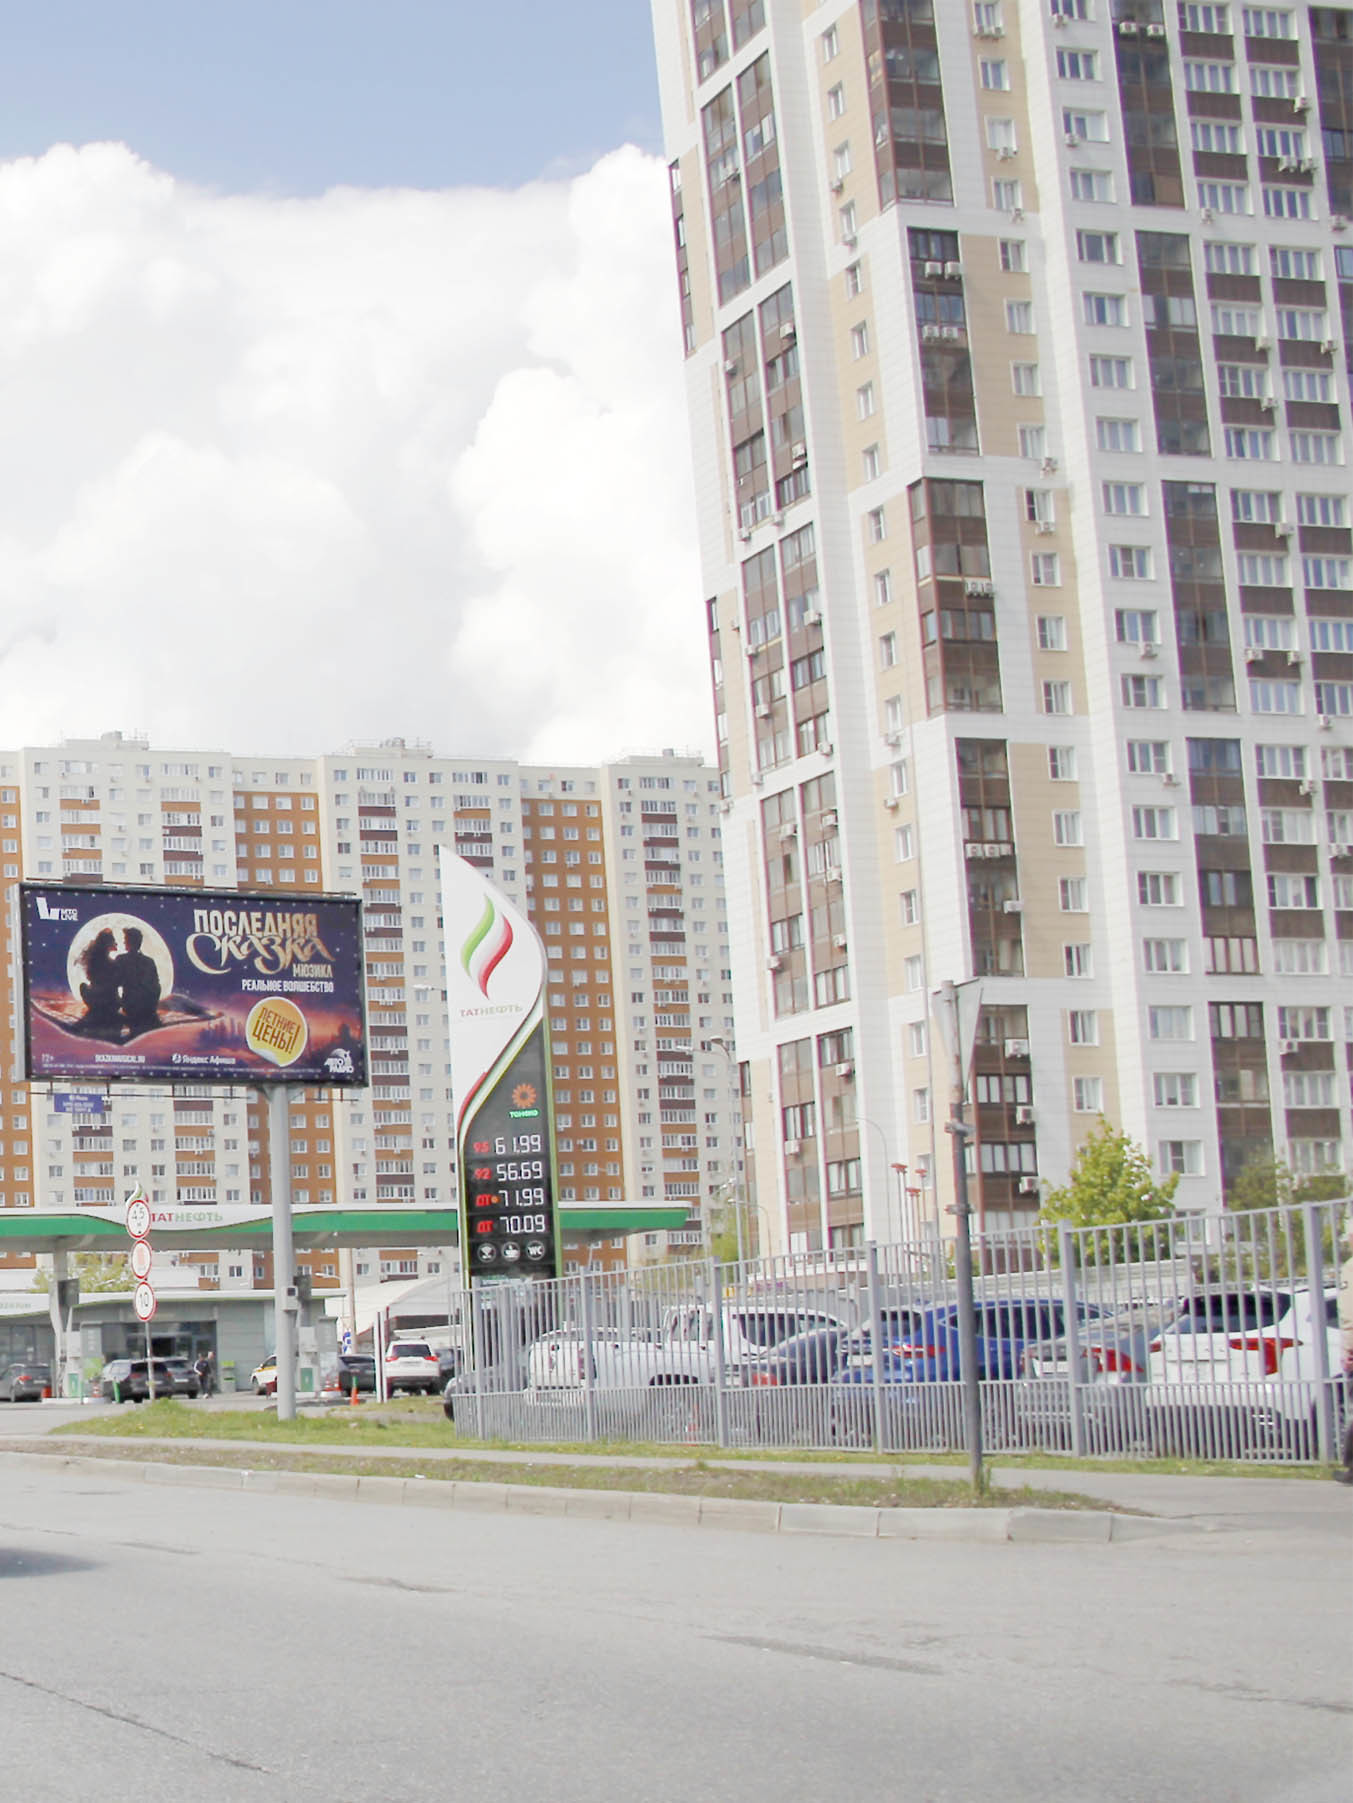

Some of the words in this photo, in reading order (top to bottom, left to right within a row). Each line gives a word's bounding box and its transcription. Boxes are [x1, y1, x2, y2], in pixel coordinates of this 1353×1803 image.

[193, 909, 318, 938] ПОСЛЕДНЯЯ
[293, 963, 333, 978] МЮЗИКЛ
[242, 979, 283, 991] РЕАЛЬНОЕ
[283, 980, 334, 993] ВОЛШЕБСТВО
[460, 1004, 523, 1017] ТАТНЕФТЬ
[258, 1007, 297, 1035] ЛЕТНИЕ
[252, 1020, 301, 1055] ЦЕНЫ!
[474, 1168, 492, 1180] 92
[497, 1161, 543, 1181] 56.69
[151, 1212, 223, 1222] ТАТНЕФТЬ
[499, 1214, 545, 1234] 70.09
[527, 1246, 543, 1255] WC
